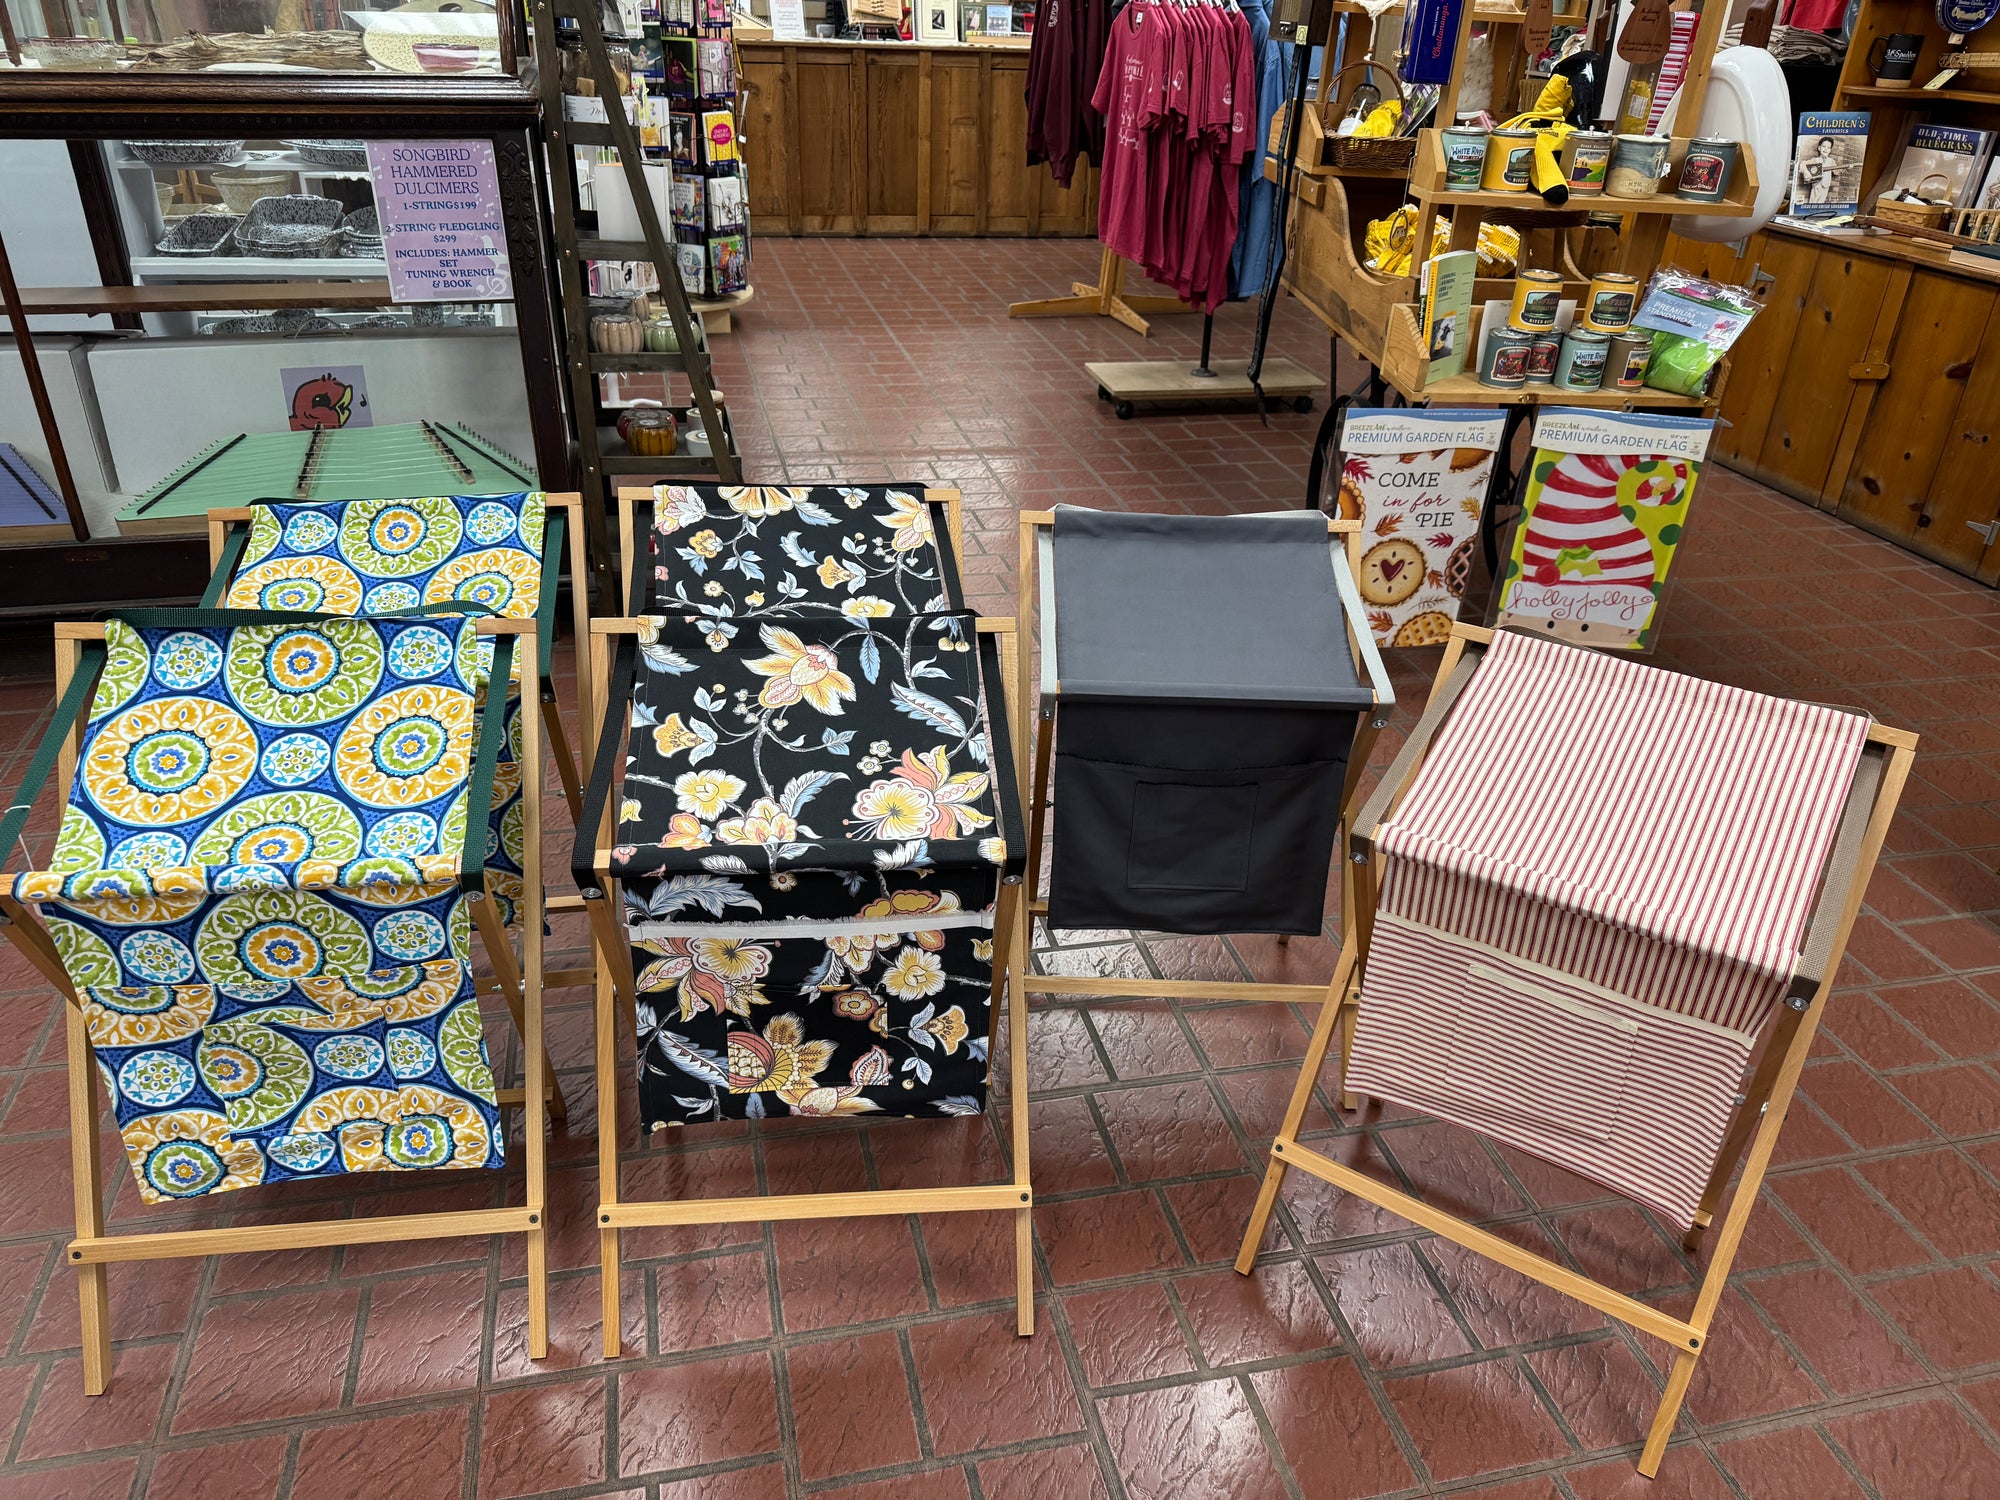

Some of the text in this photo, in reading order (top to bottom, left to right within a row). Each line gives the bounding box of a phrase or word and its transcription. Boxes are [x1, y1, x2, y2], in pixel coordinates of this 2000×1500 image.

[1806, 116, 1866, 129] CHILDREN'S
[1918, 128, 1969, 142] OLD-TIME
[1451, 145, 1470, 156] WHITE
[1915, 139, 1974, 151] BLUEGRASS
[392, 148, 471, 162] SONGBIRD
[391, 165, 478, 179] HAMMERED
[395, 181, 480, 195] DULCIMERS
[403, 200, 477, 211] 1-STRING$199
[385, 221, 500, 233] 2-STRING FLEDGLING
[433, 234, 457, 243] $299
[395, 247, 499, 258] INCLUDES: HAMMER
[439, 259, 458, 268] SET
[406, 268, 495, 279] TUNING WRENCH
[432, 279, 473, 289] & BOOK
[1645, 306, 1688, 324] STANDARD
[1653, 301, 1697, 320] PREMIUM
[1348, 432, 1484, 443] PREMIUM GARDEN FLAG
[1539, 429, 1688, 452] PREMIUM GARDEN FLAG
[1378, 472, 1440, 488] COME
[1382, 492, 1451, 513] in for
[1415, 512, 1454, 528] PIE
[1509, 582, 1655, 621] holly jolly
